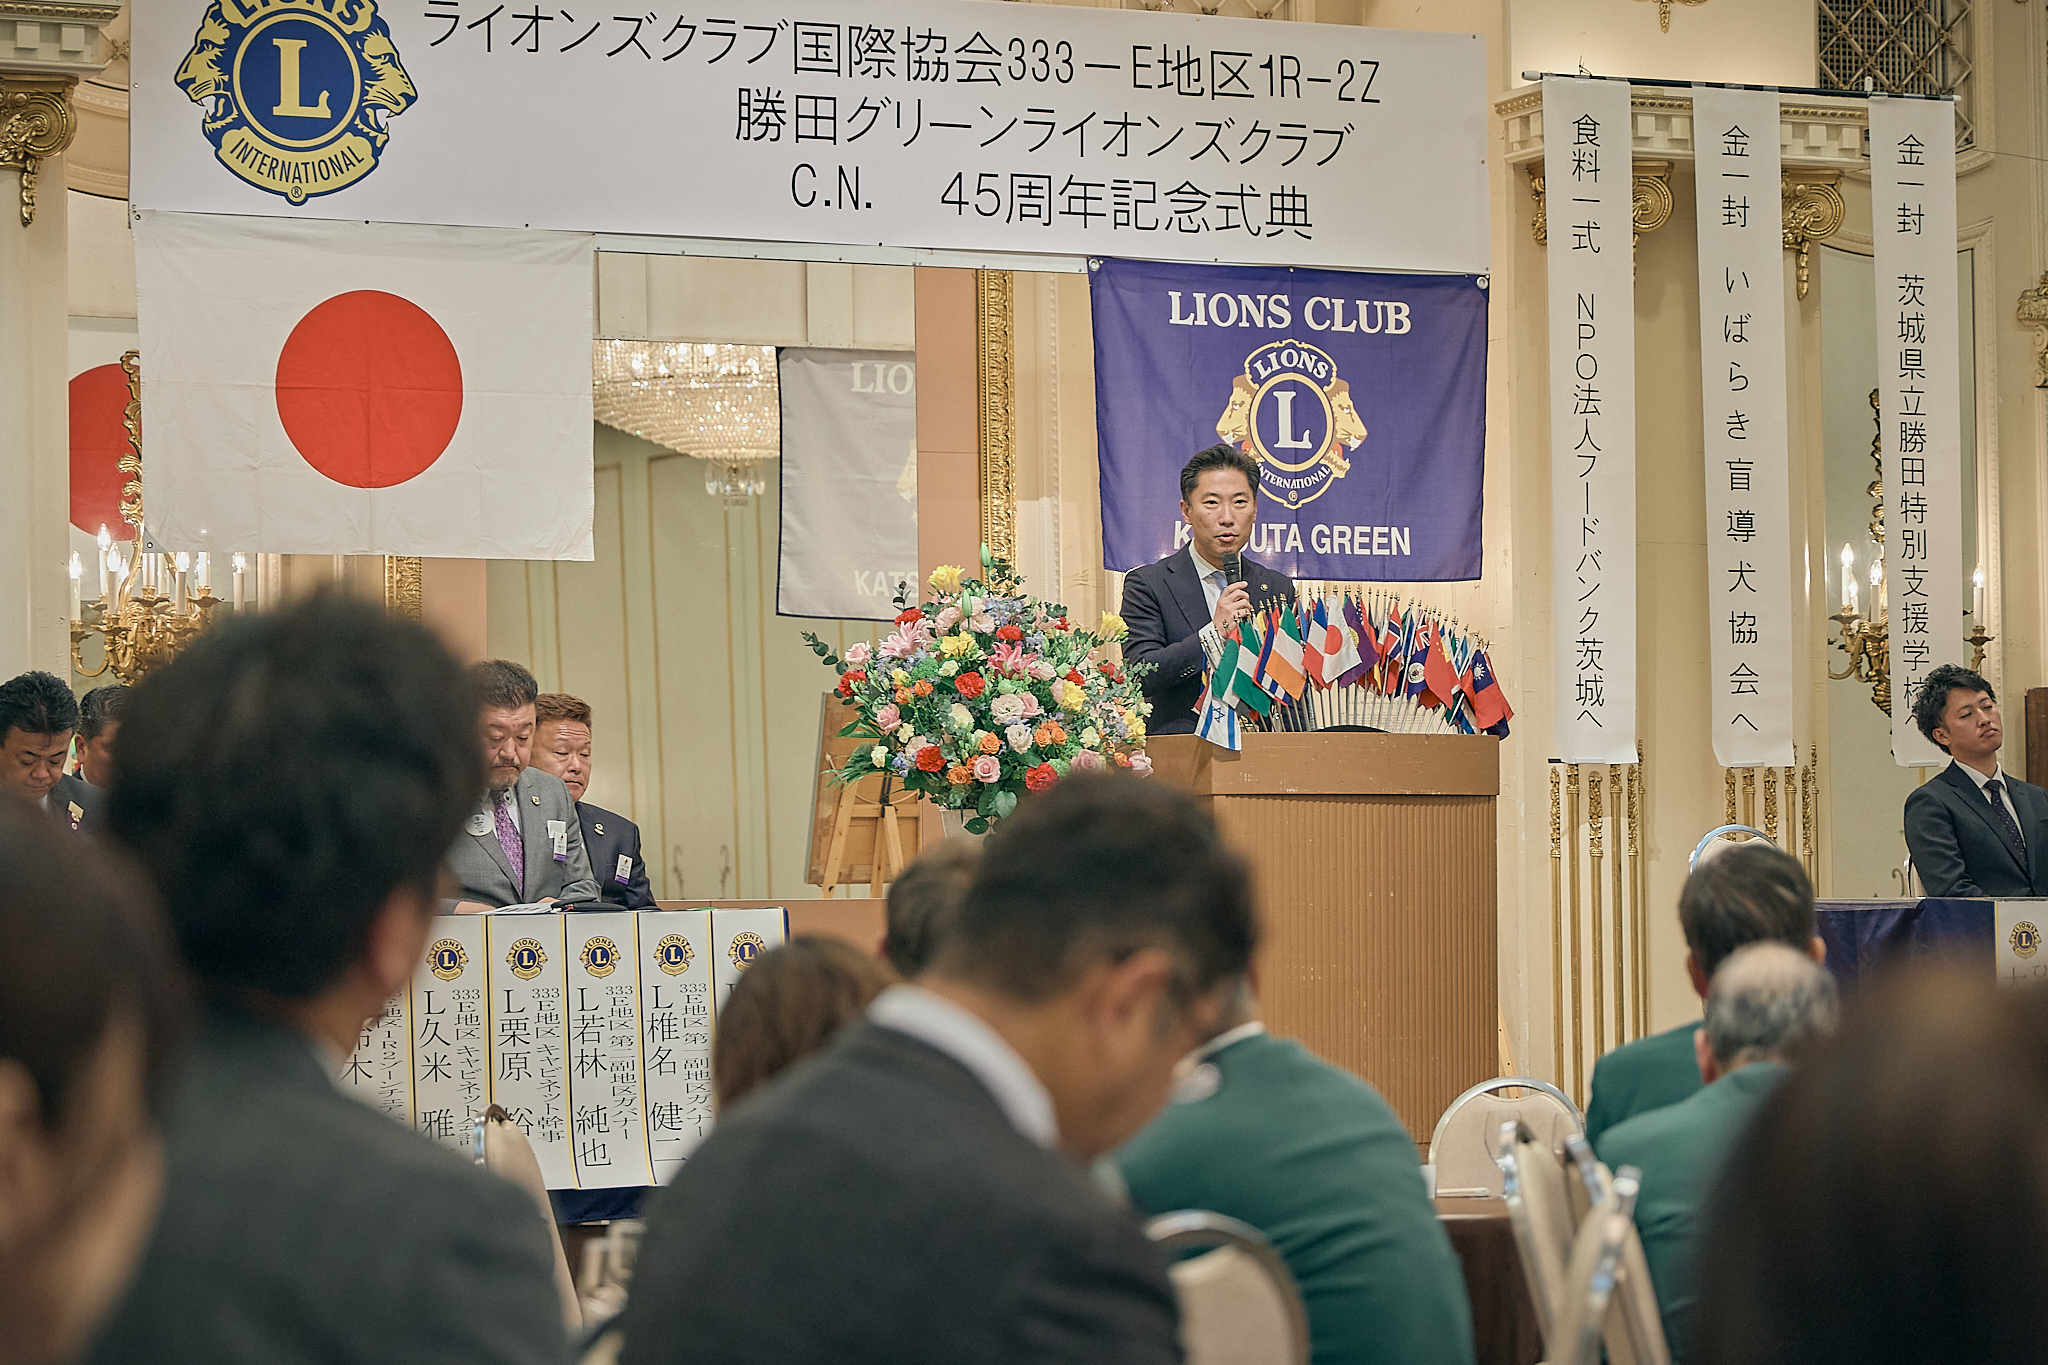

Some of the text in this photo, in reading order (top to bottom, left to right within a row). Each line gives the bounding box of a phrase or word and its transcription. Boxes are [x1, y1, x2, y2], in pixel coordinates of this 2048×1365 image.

[272, 38, 331, 119] L
[735, 87, 1354, 168] 勝田グリーンライオンズクラブ
[229, 137, 365, 184] INTERNATIONAL
[1722, 124, 1750, 228] 金一封
[792, 163, 1313, 240] C.N. 45周年記念式典
[1896, 133, 1925, 236] 金一封
[1168, 290, 1412, 335] LIONS CLUB
[1253, 349, 1329, 379] LIONS
[1272, 391, 1313, 449] L
[1572, 113, 1605, 728] 食料一式 NPO法人フードバンク茨城へ
[1257, 463, 1331, 489] NTERNATIONAL
[1174, 520, 1411, 556] KUTA GREEN
[435, 940, 460, 949] LIONS
[515, 939, 538, 949] LIONS
[587, 938, 611, 946] LIONS
[595, 949, 606, 964] L
[662, 935, 686, 945] LIONS
[669, 947, 680, 962] L
[736, 933, 760, 943] LIONS
[743, 945, 755, 960] L
[2021, 932, 2031, 946] L
[443, 952, 454, 967] L
[522, 951, 533, 966] L
[420, 990, 452, 1083] L久米
[498, 989, 532, 1082] L栗原
[572, 987, 608, 1079] L若林
[646, 985, 681, 1077] L椎名
[576, 1104, 612, 1167] 純也
